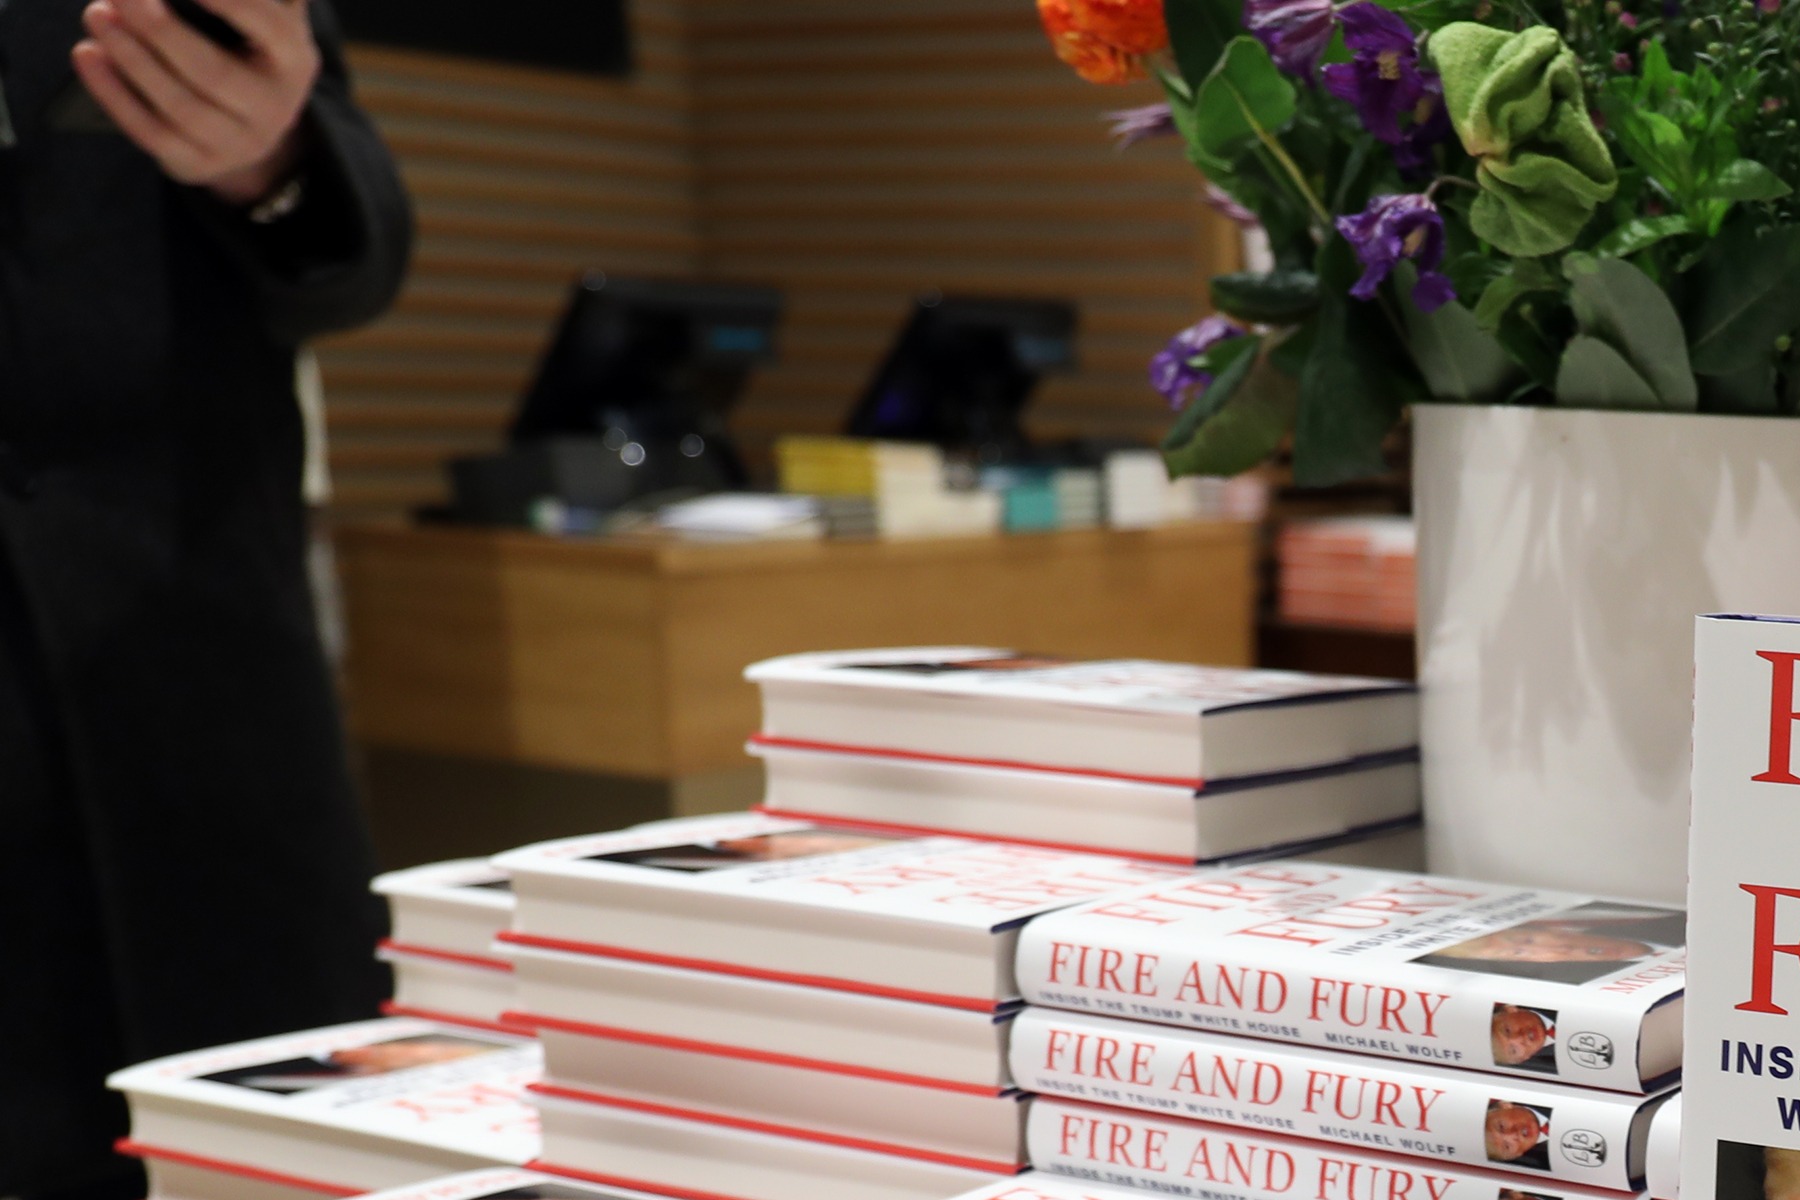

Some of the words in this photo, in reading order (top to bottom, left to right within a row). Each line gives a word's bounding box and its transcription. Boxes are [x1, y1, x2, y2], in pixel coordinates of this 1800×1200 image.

[1083, 867, 1341, 925] FIRE
[1226, 880, 1490, 948] FURY
[1039, 991, 1094, 1007] INSIDE
[1098, 999, 1124, 1012] THE
[1131, 1003, 1184, 1020] TRUMP
[1189, 1012, 1240, 1030] WHITE
[1247, 1021, 1300, 1038] HOUSE
[1048, 942, 1159, 997] FIRE
[1175, 961, 1289, 1014] AND
[1309, 977, 1449, 1038] FURY
[1325, 1032, 1399, 1053] MICHAEL
[1404, 1044, 1463, 1061] WOLFF
[1060, 1114, 1168, 1172] FIRE
[1186, 1137, 1296, 1192] AND
